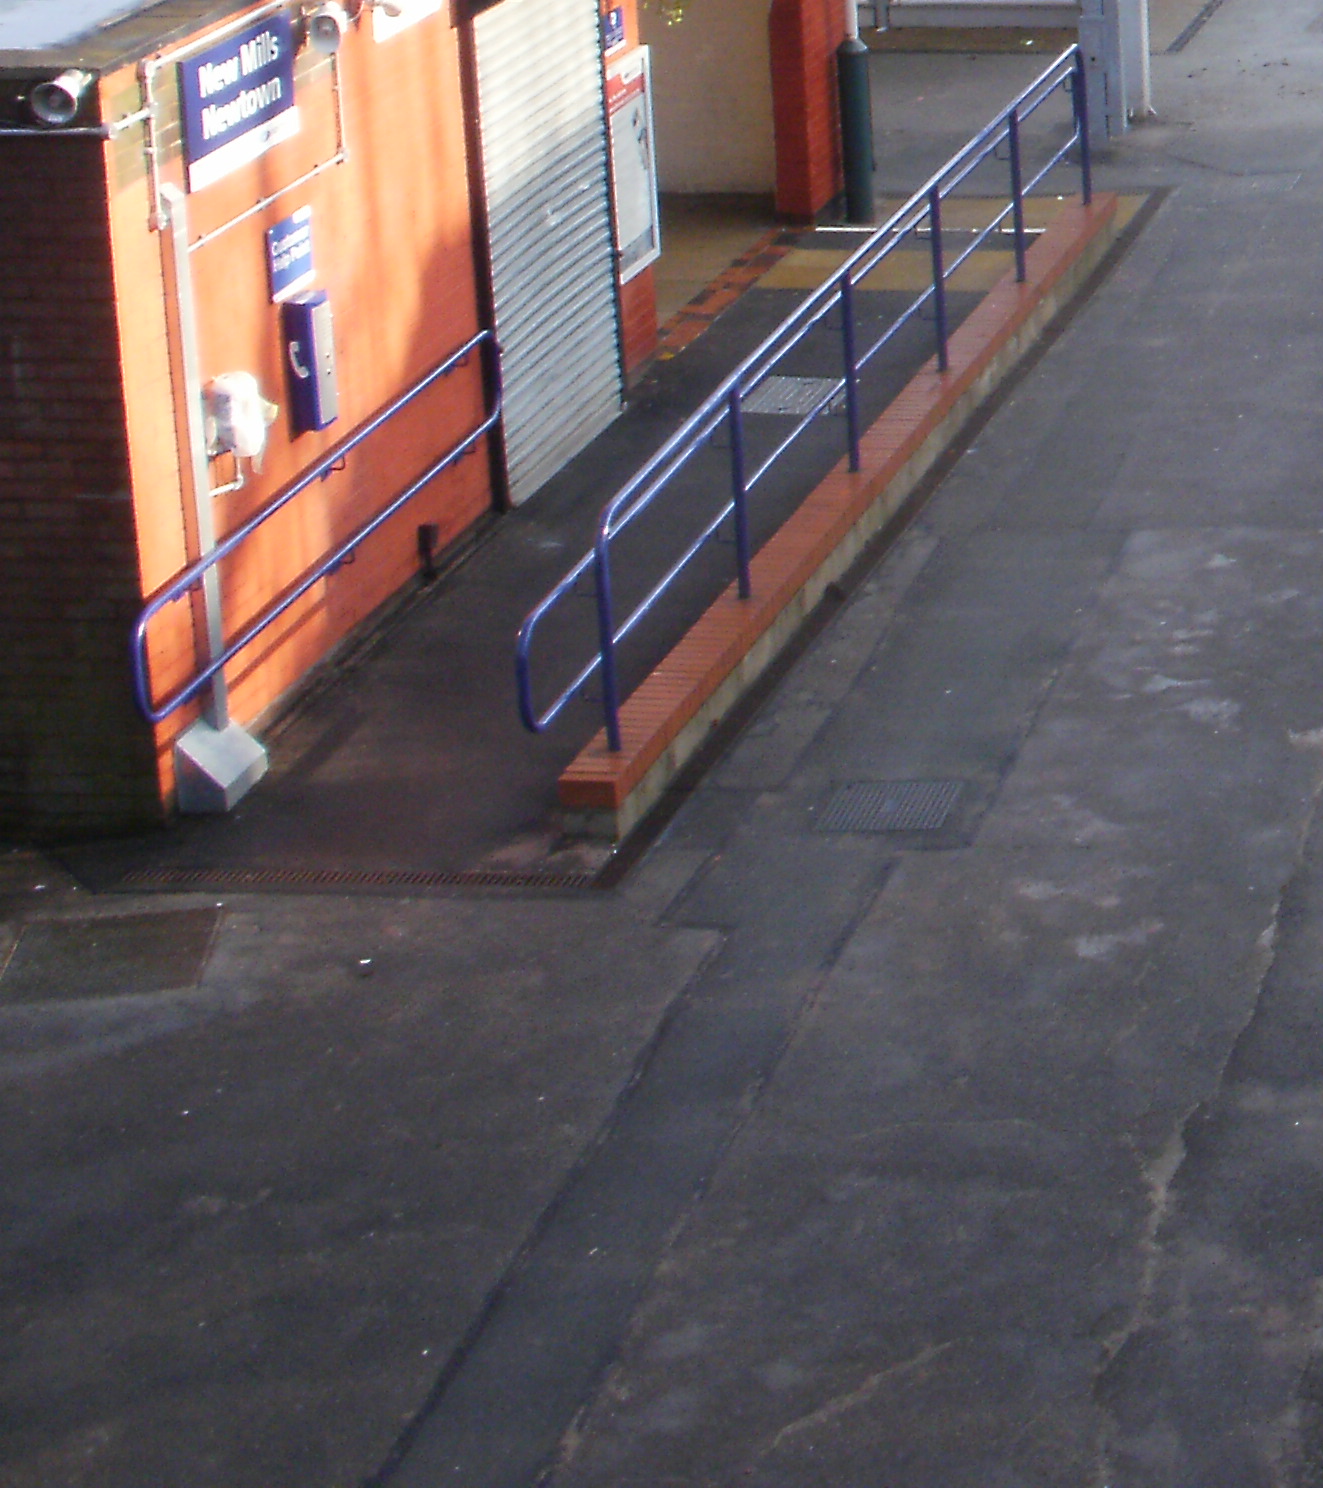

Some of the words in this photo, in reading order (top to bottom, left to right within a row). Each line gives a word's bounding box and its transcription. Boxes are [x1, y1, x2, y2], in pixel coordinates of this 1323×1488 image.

[198, 55, 239, 99] New
[240, 30, 281, 76] Mills
[201, 76, 283, 141] Newtown
